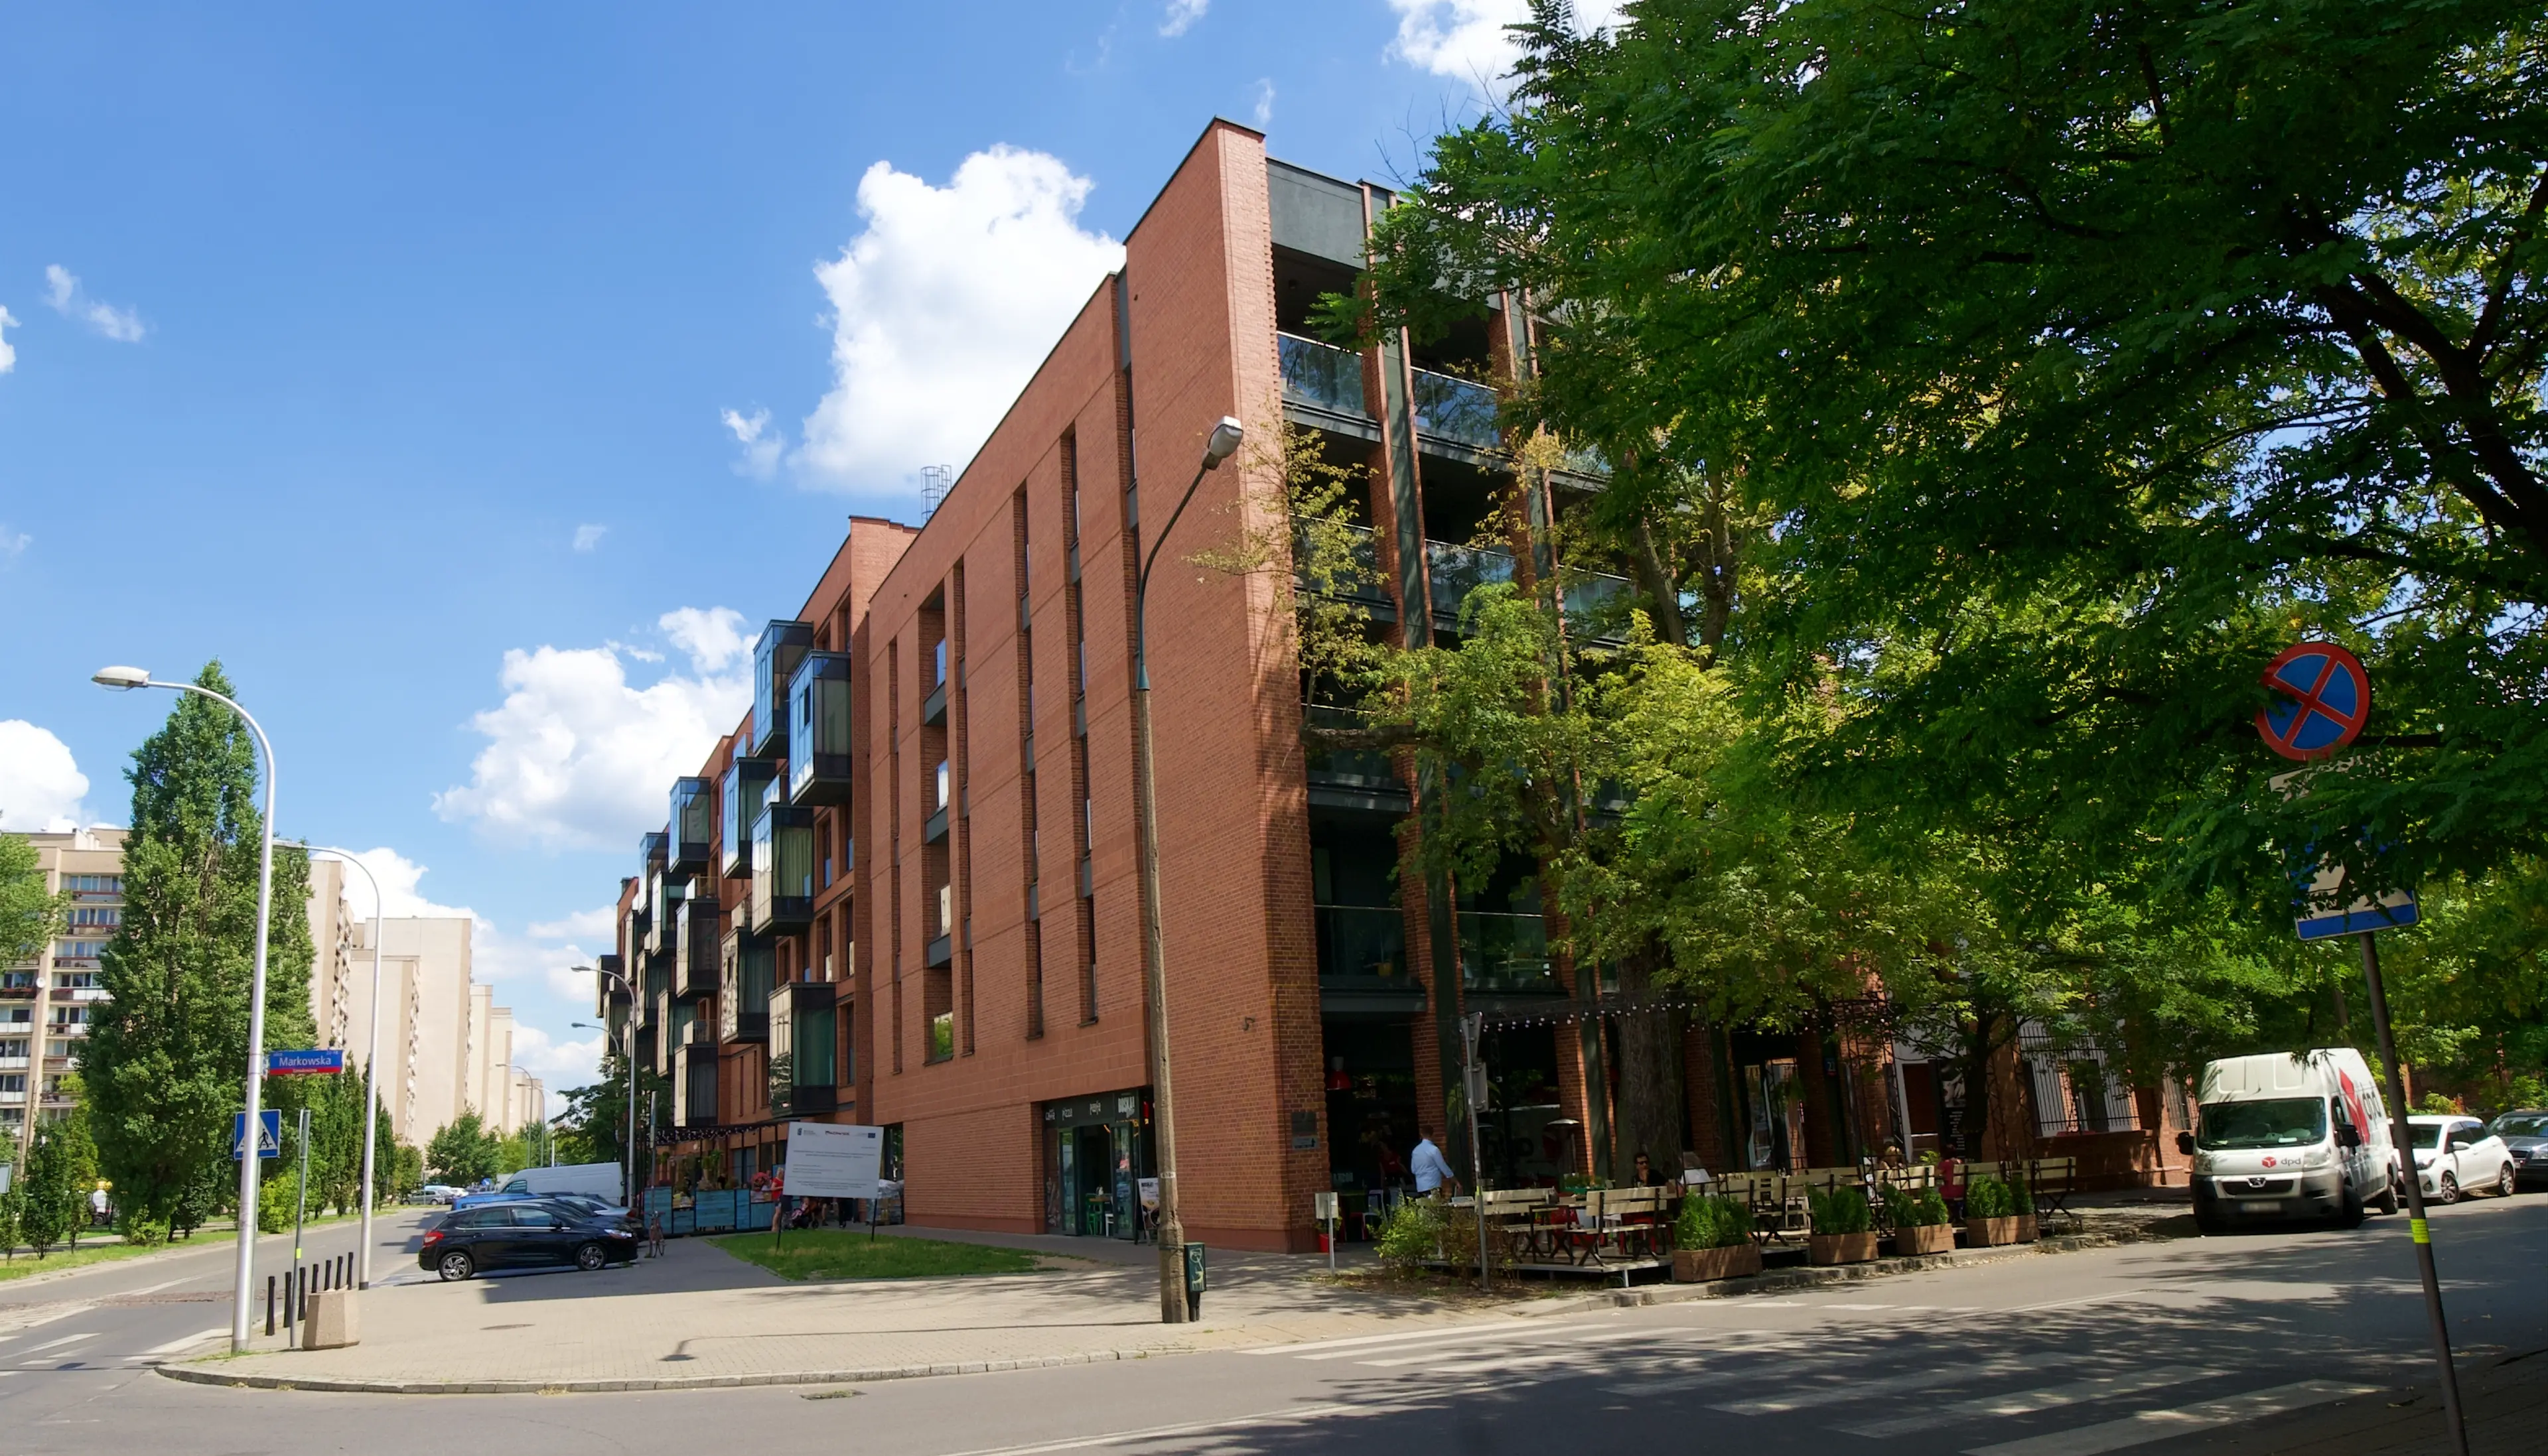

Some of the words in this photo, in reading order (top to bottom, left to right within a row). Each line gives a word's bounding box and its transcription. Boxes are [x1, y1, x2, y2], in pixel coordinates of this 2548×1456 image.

[279, 1055, 331, 1067] Markowska
[2360, 1081, 2382, 1130] dpd
[2281, 1157, 2301, 1167] dpd
